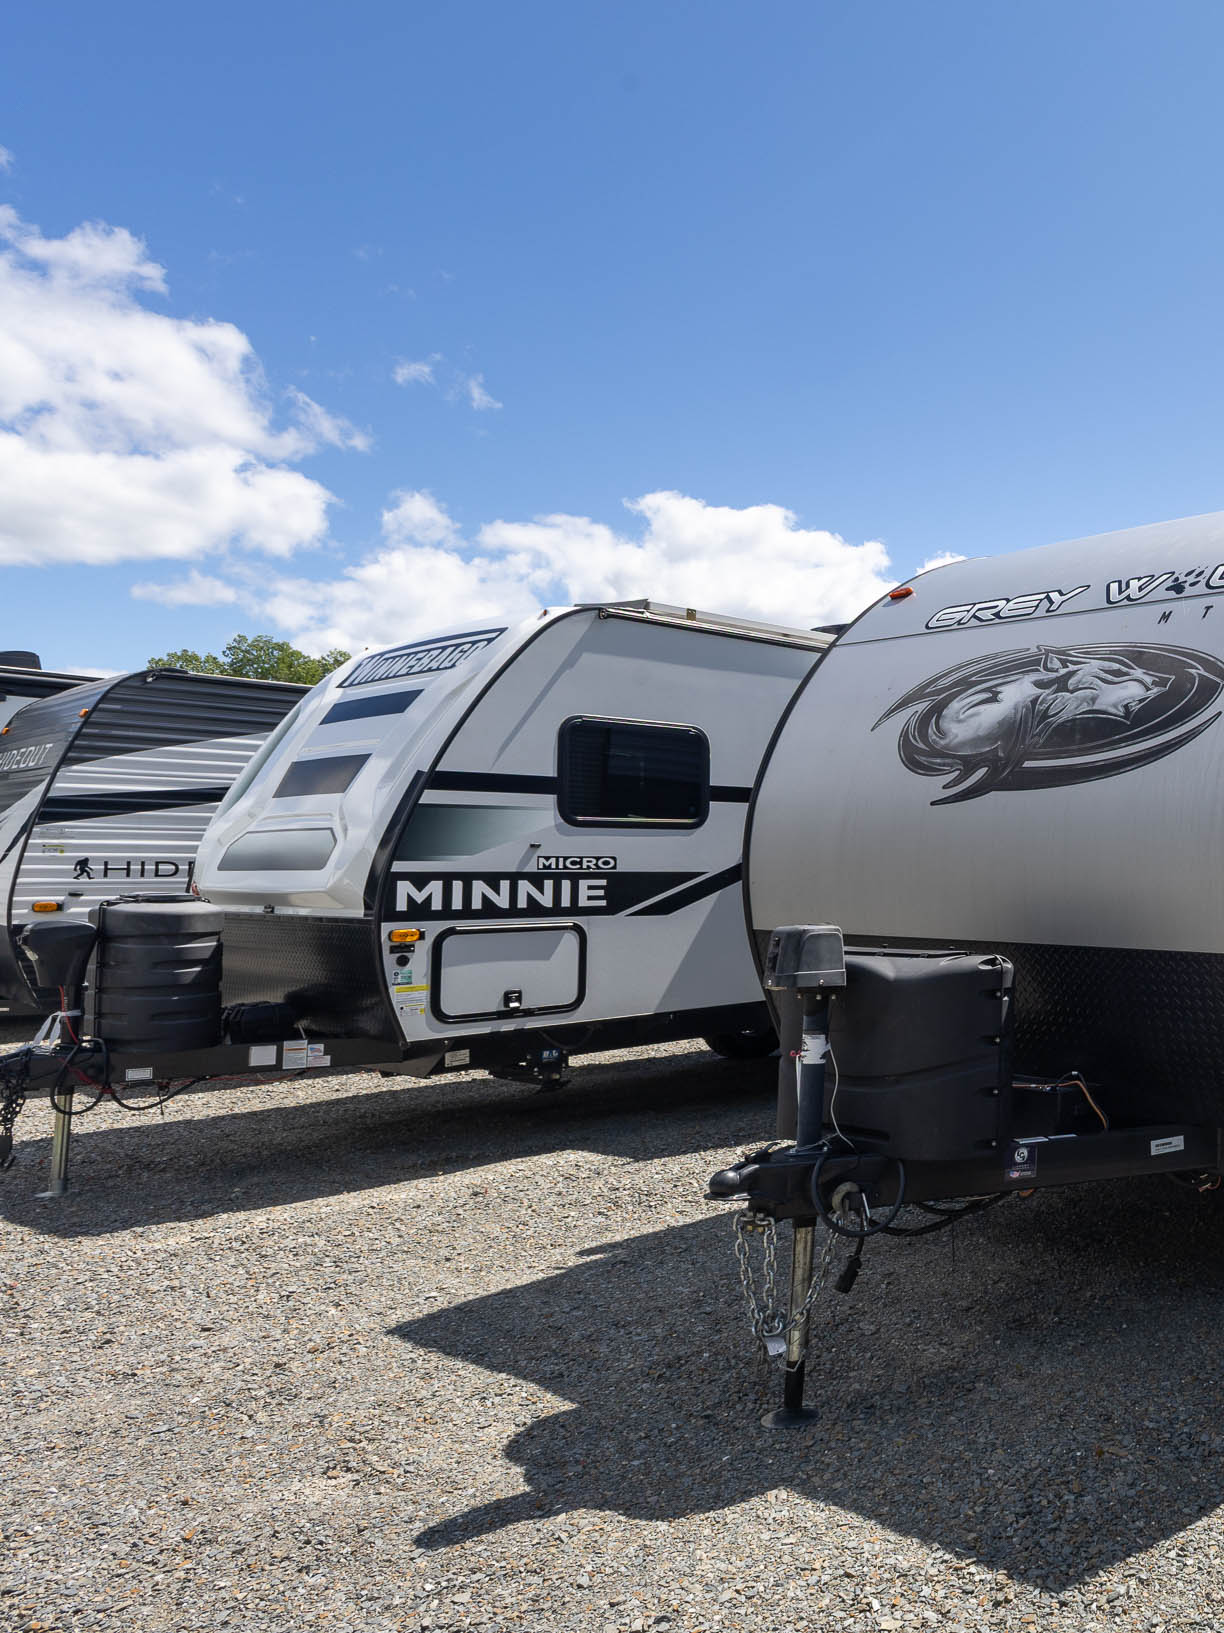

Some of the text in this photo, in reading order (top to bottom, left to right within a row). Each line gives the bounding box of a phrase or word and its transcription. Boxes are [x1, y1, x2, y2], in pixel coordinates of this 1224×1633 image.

[925, 584, 1091, 630] GREY
[341, 640, 490, 688] WINNEBAGO
[538, 857, 616, 869] MICRO
[396, 879, 608, 912] MINNIE
